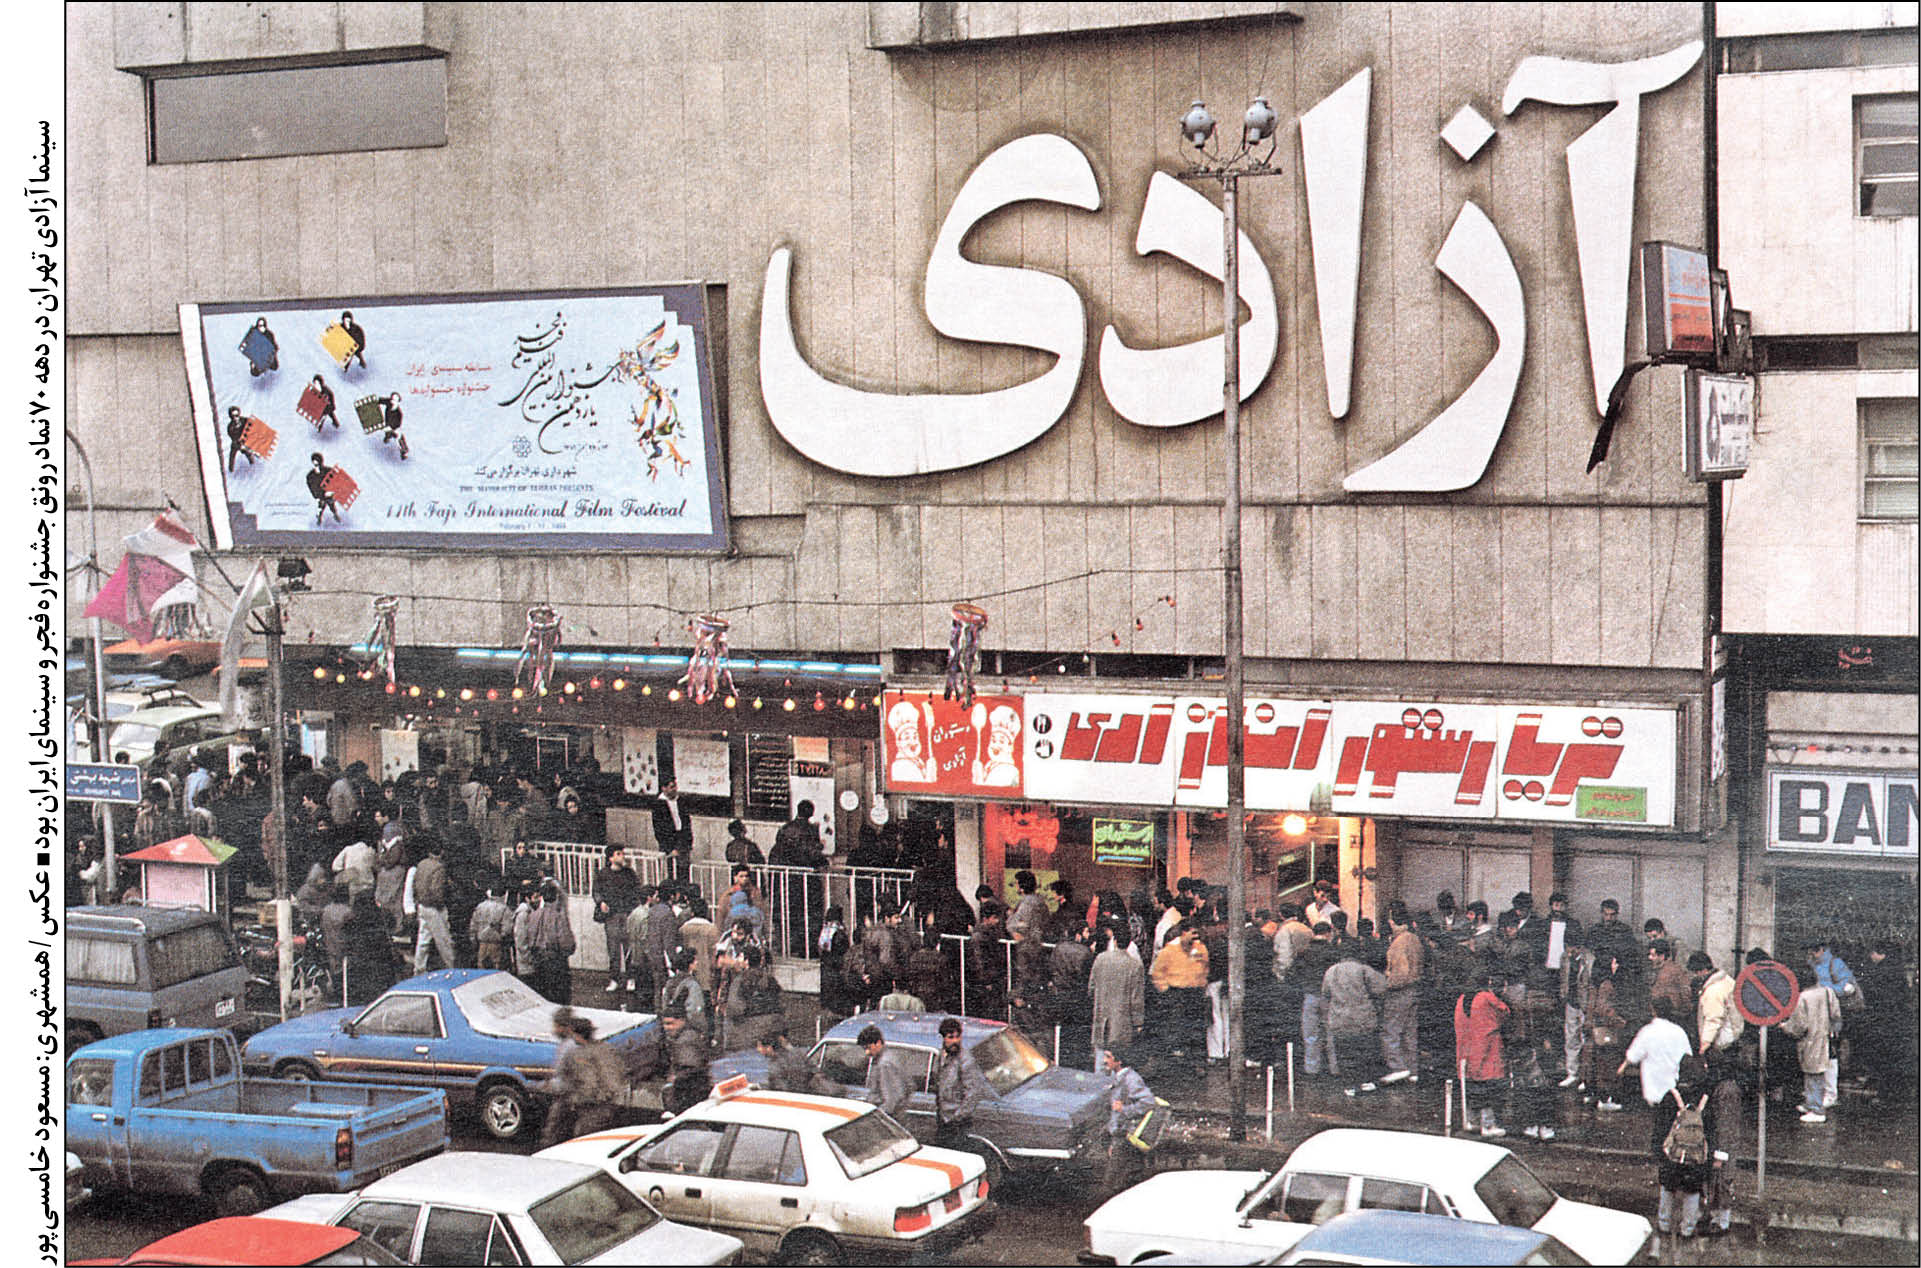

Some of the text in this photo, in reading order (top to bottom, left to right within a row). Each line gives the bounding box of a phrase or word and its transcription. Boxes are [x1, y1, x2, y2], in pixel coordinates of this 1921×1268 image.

[760, 40, 1704, 493] آزادی
[424, 500, 457, 526] Fajr
[464, 499, 569, 518] International
[574, 498, 614, 518] Film
[620, 498, 688, 518] Festival
[933, 721, 971, 744] رستوران
[943, 746, 967, 772] آزادی
